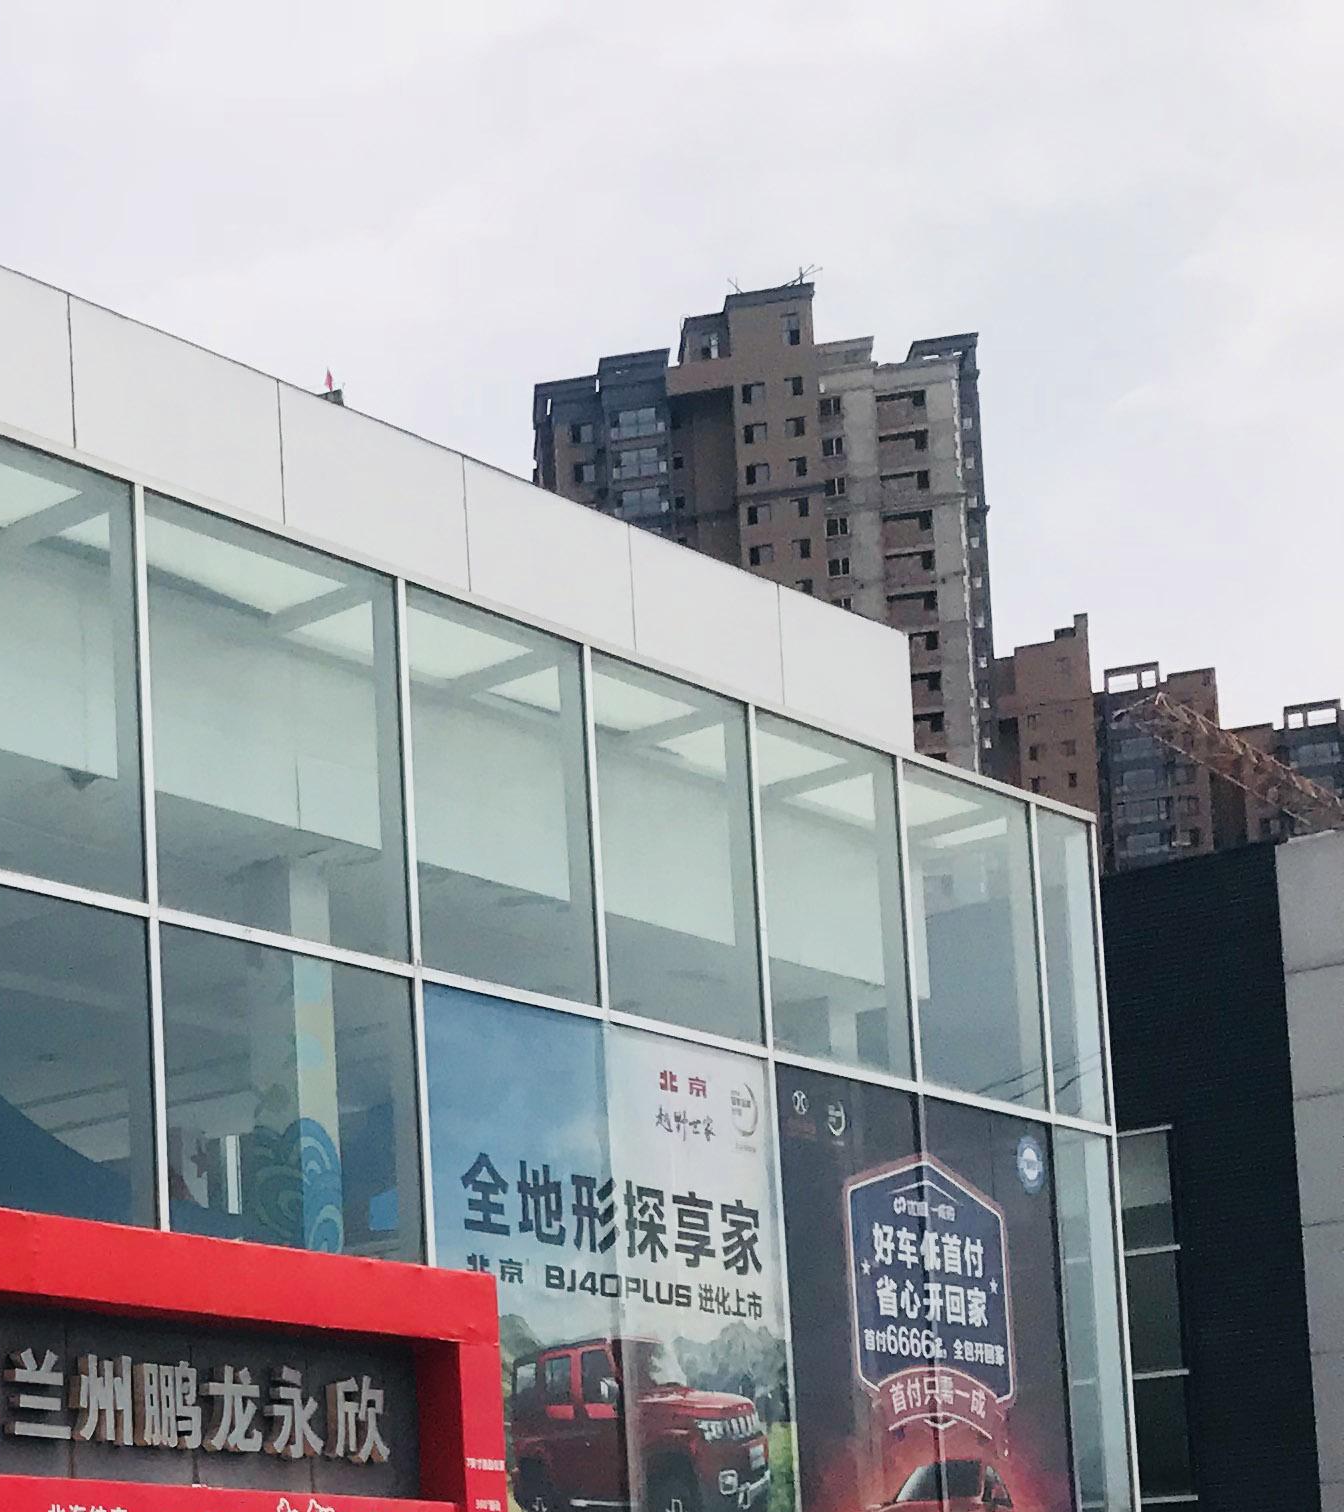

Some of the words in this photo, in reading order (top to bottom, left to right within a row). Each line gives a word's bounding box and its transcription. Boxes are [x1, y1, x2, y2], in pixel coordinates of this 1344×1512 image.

[659, 1069, 708, 1099] 北京
[460, 1152, 764, 1277] 全地形探享家
[872, 1222, 984, 1278] 好车低首付
[698, 1283, 763, 1321] 进化上市
[876, 1275, 988, 1328] 省心开回家
[5, 1347, 391, 1465] 兰州鹏龙永欣
